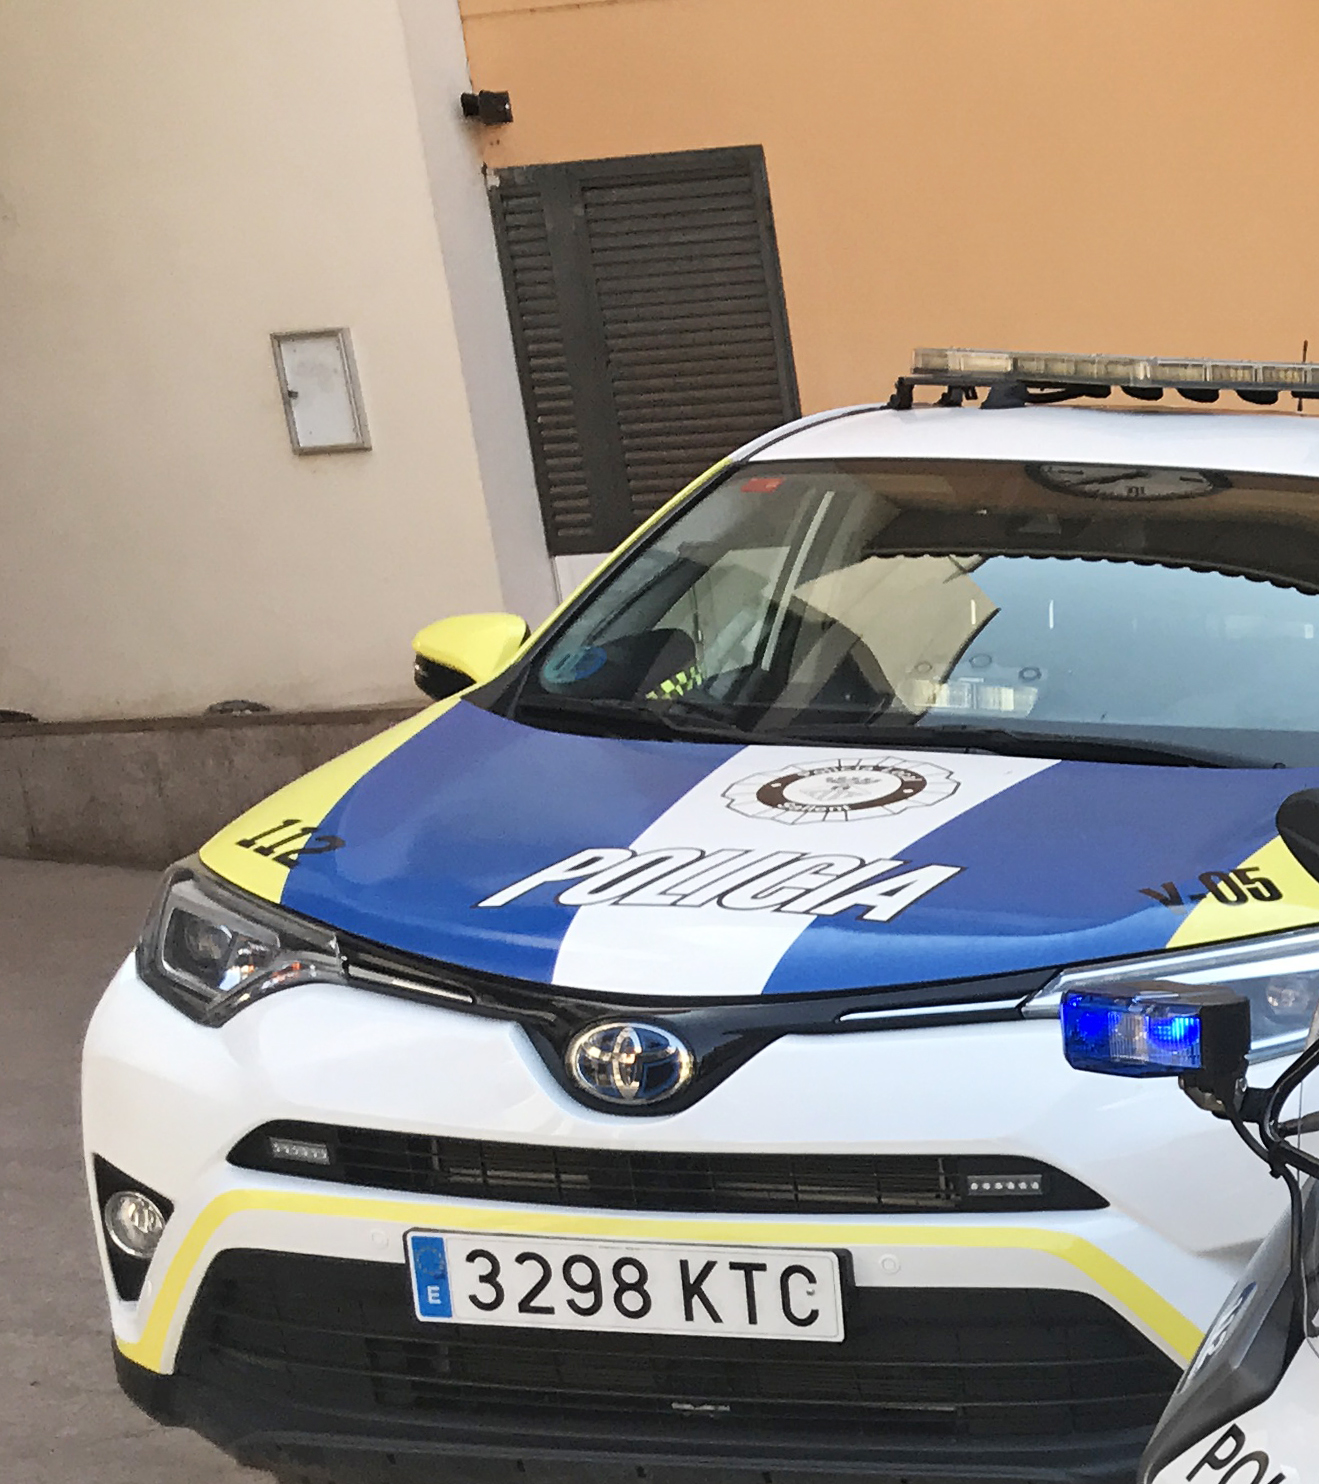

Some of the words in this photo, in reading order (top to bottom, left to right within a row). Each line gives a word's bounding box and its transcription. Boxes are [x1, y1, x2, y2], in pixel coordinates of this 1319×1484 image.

[235, 819, 346, 869] 112
[470, 847, 968, 923] POLICIA
[1138, 866, 1283, 915] V-05
[426, 1285, 441, 1305] E
[465, 1248, 652, 1320] 3298
[679, 1258, 820, 1328] KTC
